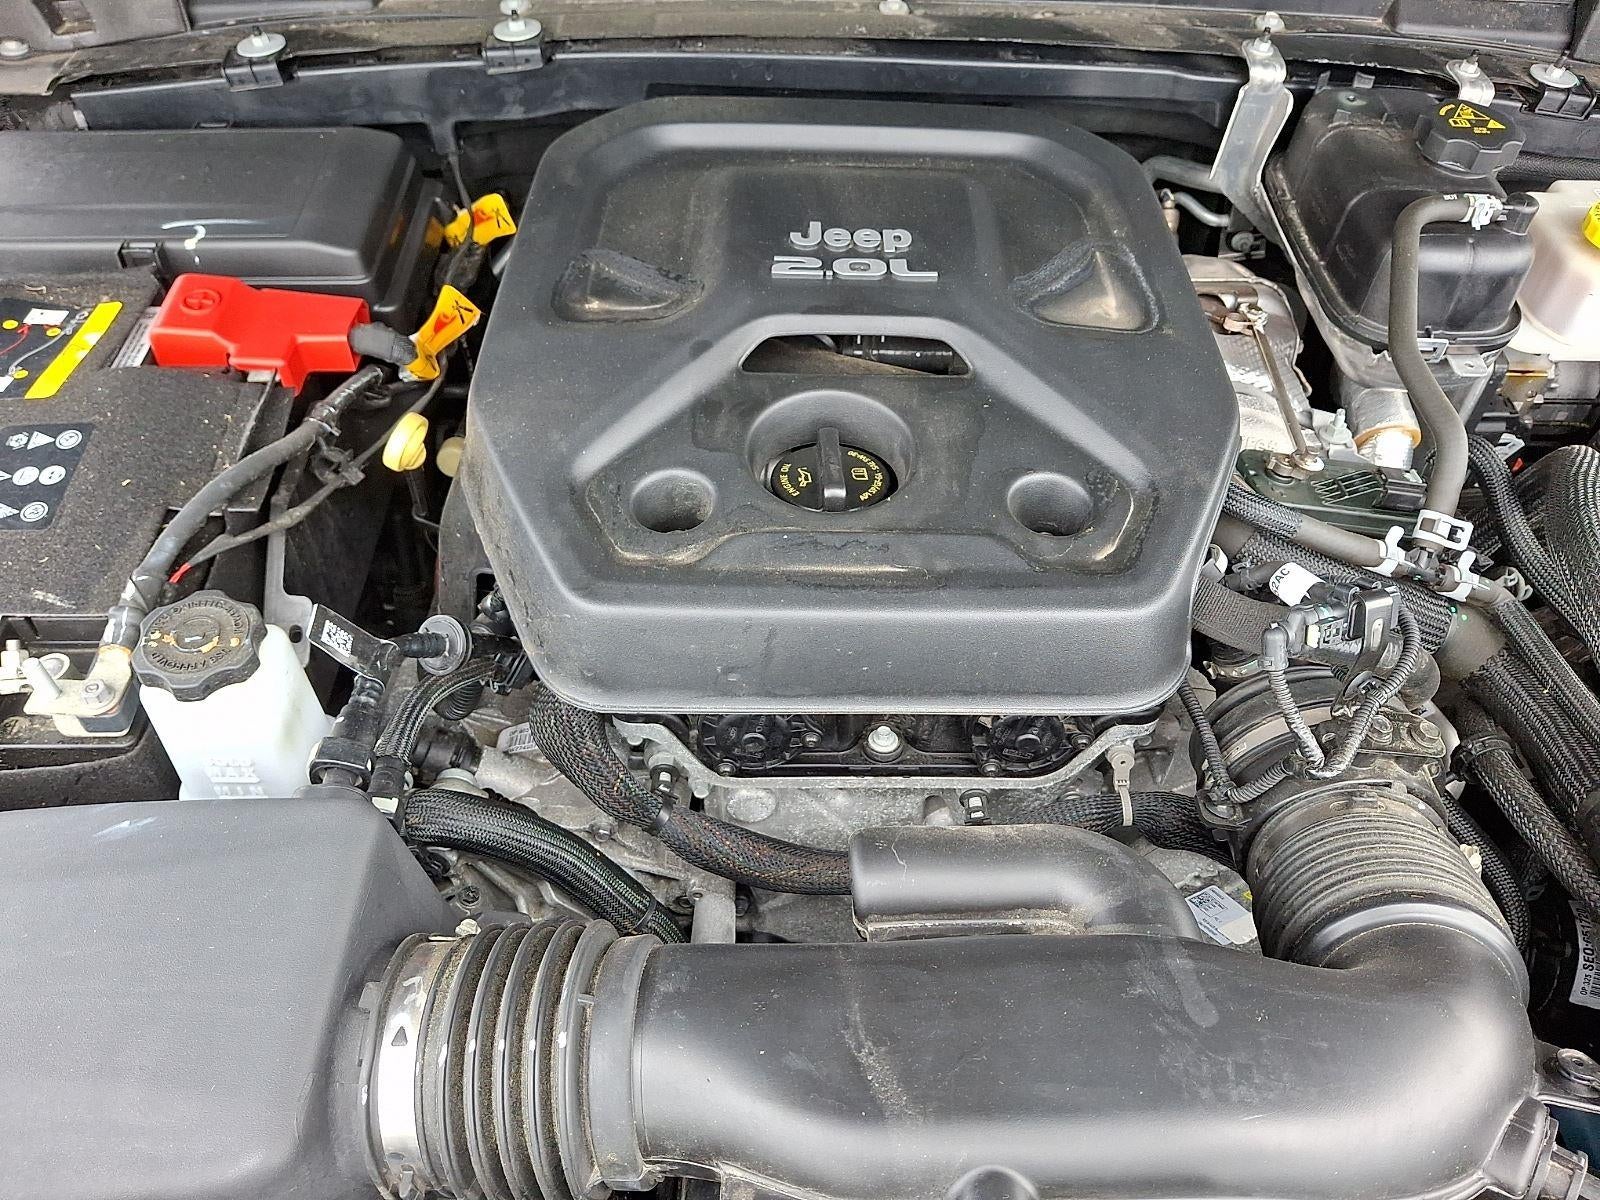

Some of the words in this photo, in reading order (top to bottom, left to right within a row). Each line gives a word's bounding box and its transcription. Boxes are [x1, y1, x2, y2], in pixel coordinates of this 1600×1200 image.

[789, 221, 912, 254] Jeep
[771, 255, 938, 281] 2.0L
[780, 462, 792, 473] OIL
[779, 474, 800, 497] ENGINE
